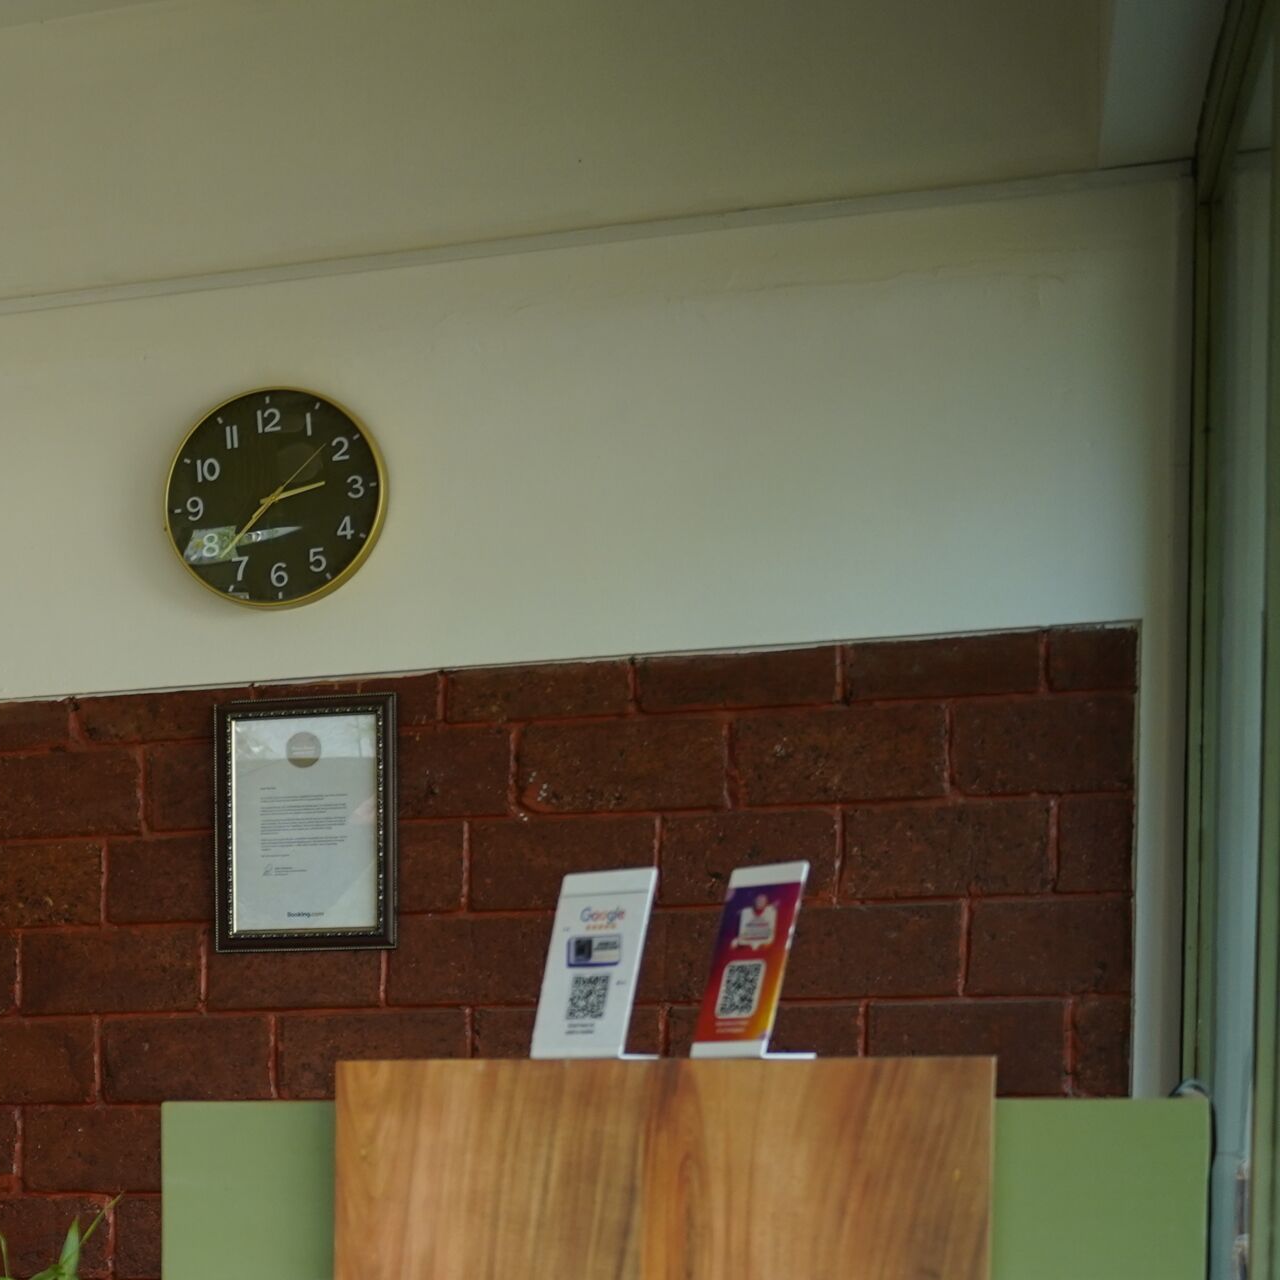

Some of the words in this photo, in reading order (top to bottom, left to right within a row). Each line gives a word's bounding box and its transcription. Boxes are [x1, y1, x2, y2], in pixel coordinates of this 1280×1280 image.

[257, 408, 281, 433] 12
[306, 412, 312, 436] 1
[226, 425, 238, 449] 11
[332, 437, 350, 461] 2
[197, 458, 220, 482] 10
[346, 475, 364, 498] 3
[186, 497, 204, 521] 9
[337, 516, 354, 540] 4
[202, 533, 219, 557] 8
[232, 556, 249, 581] 7
[309, 548, 326, 572] 5
[271, 562, 288, 587] 6
[580, 905, 625, 924] Google
